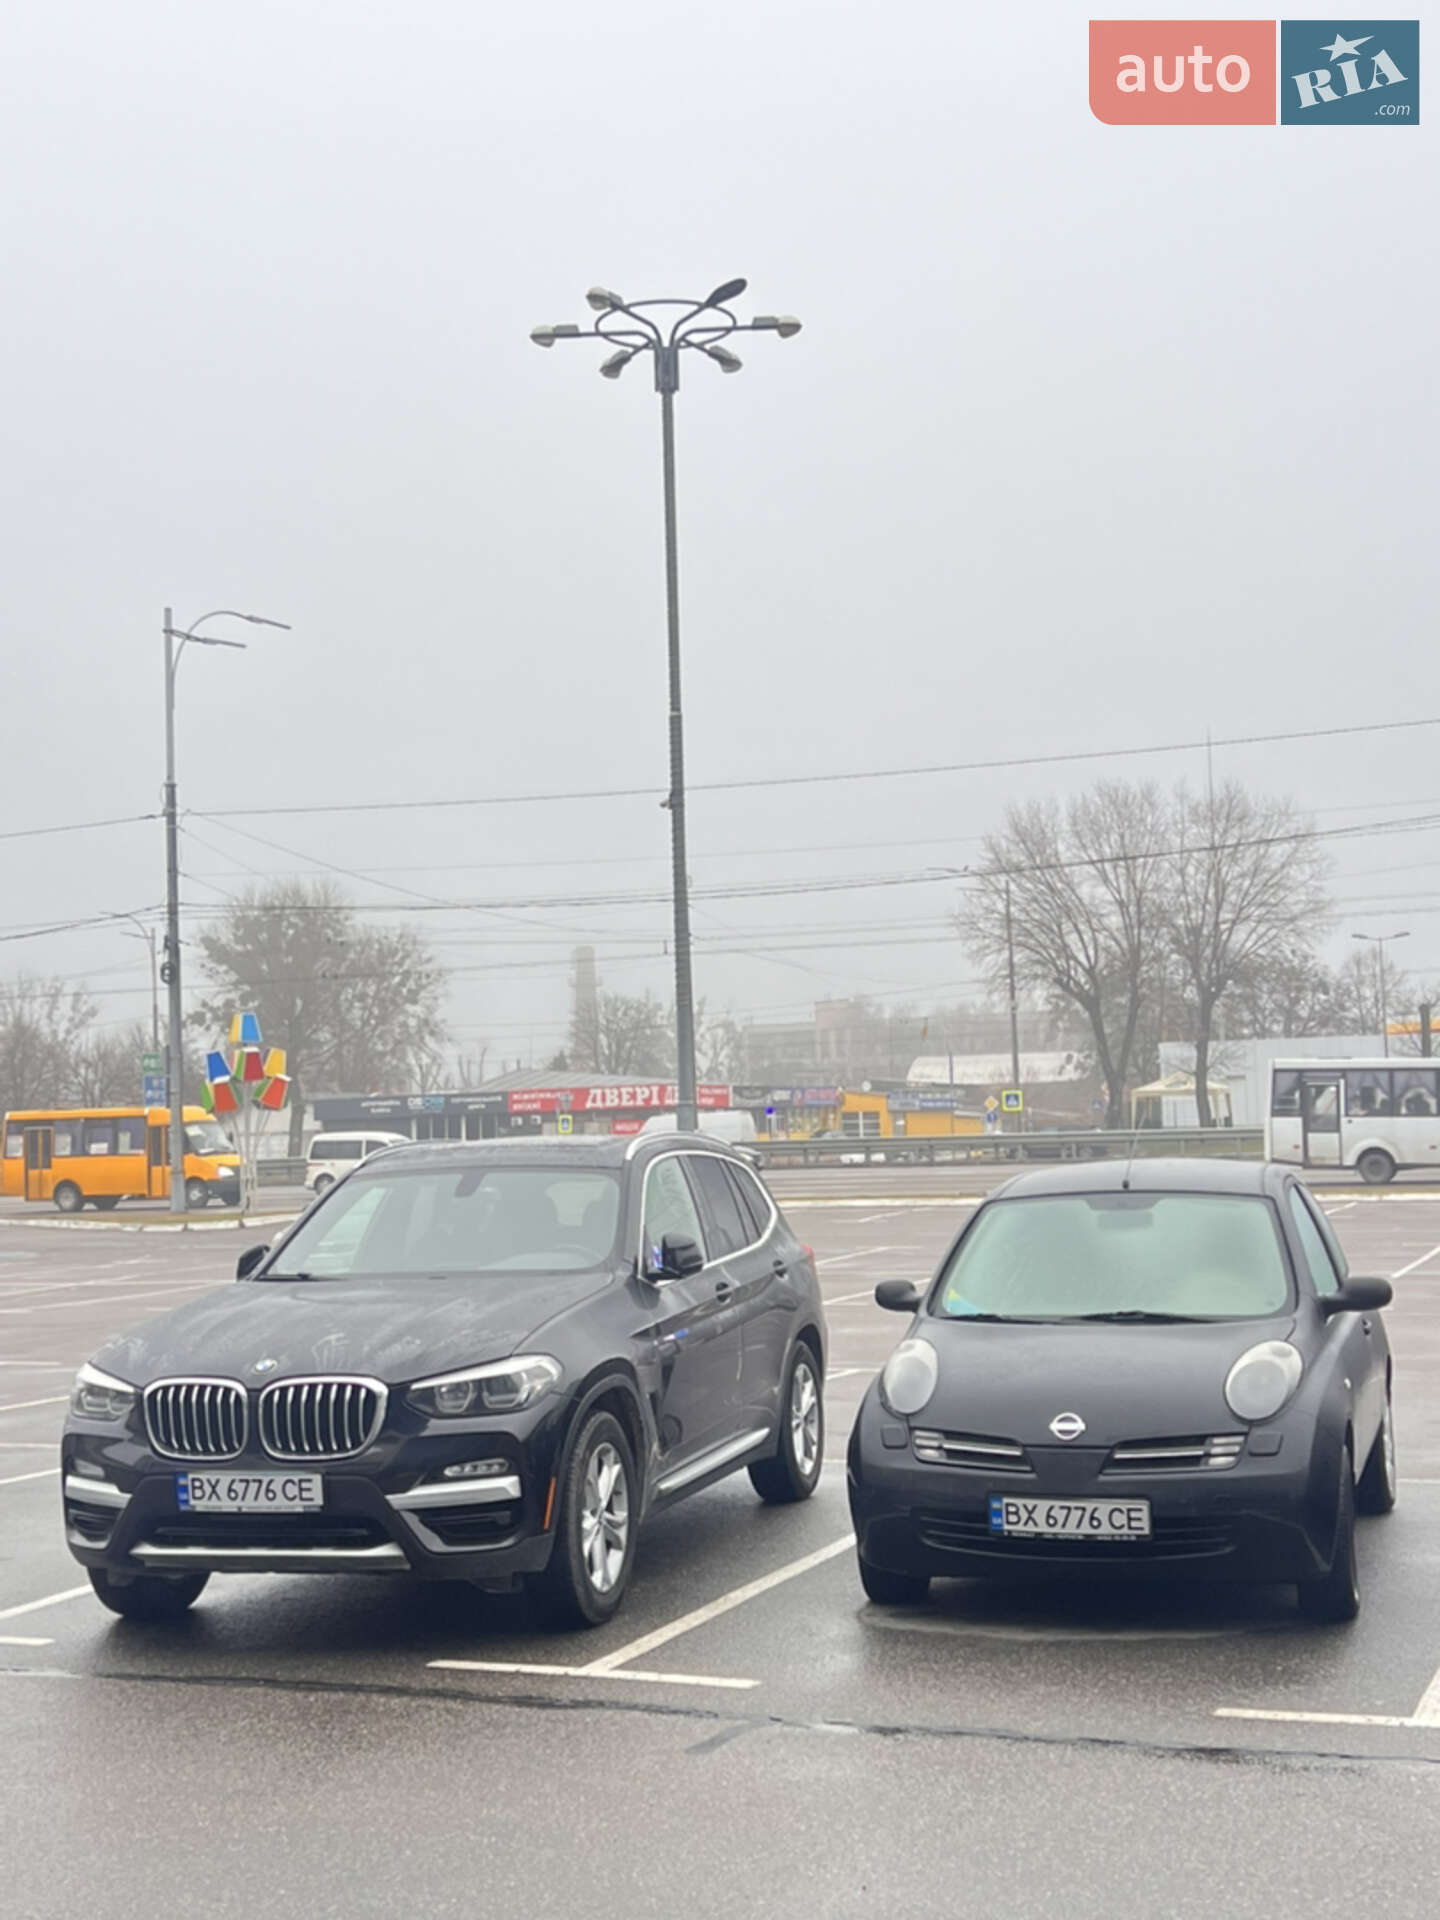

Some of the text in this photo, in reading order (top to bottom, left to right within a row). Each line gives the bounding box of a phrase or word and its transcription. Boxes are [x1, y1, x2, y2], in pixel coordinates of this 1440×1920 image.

[585, 1085, 660, 1109] ДВЕРІ
[227, 1478, 277, 1502] 6776
[1045, 1505, 1102, 1530] 6776
